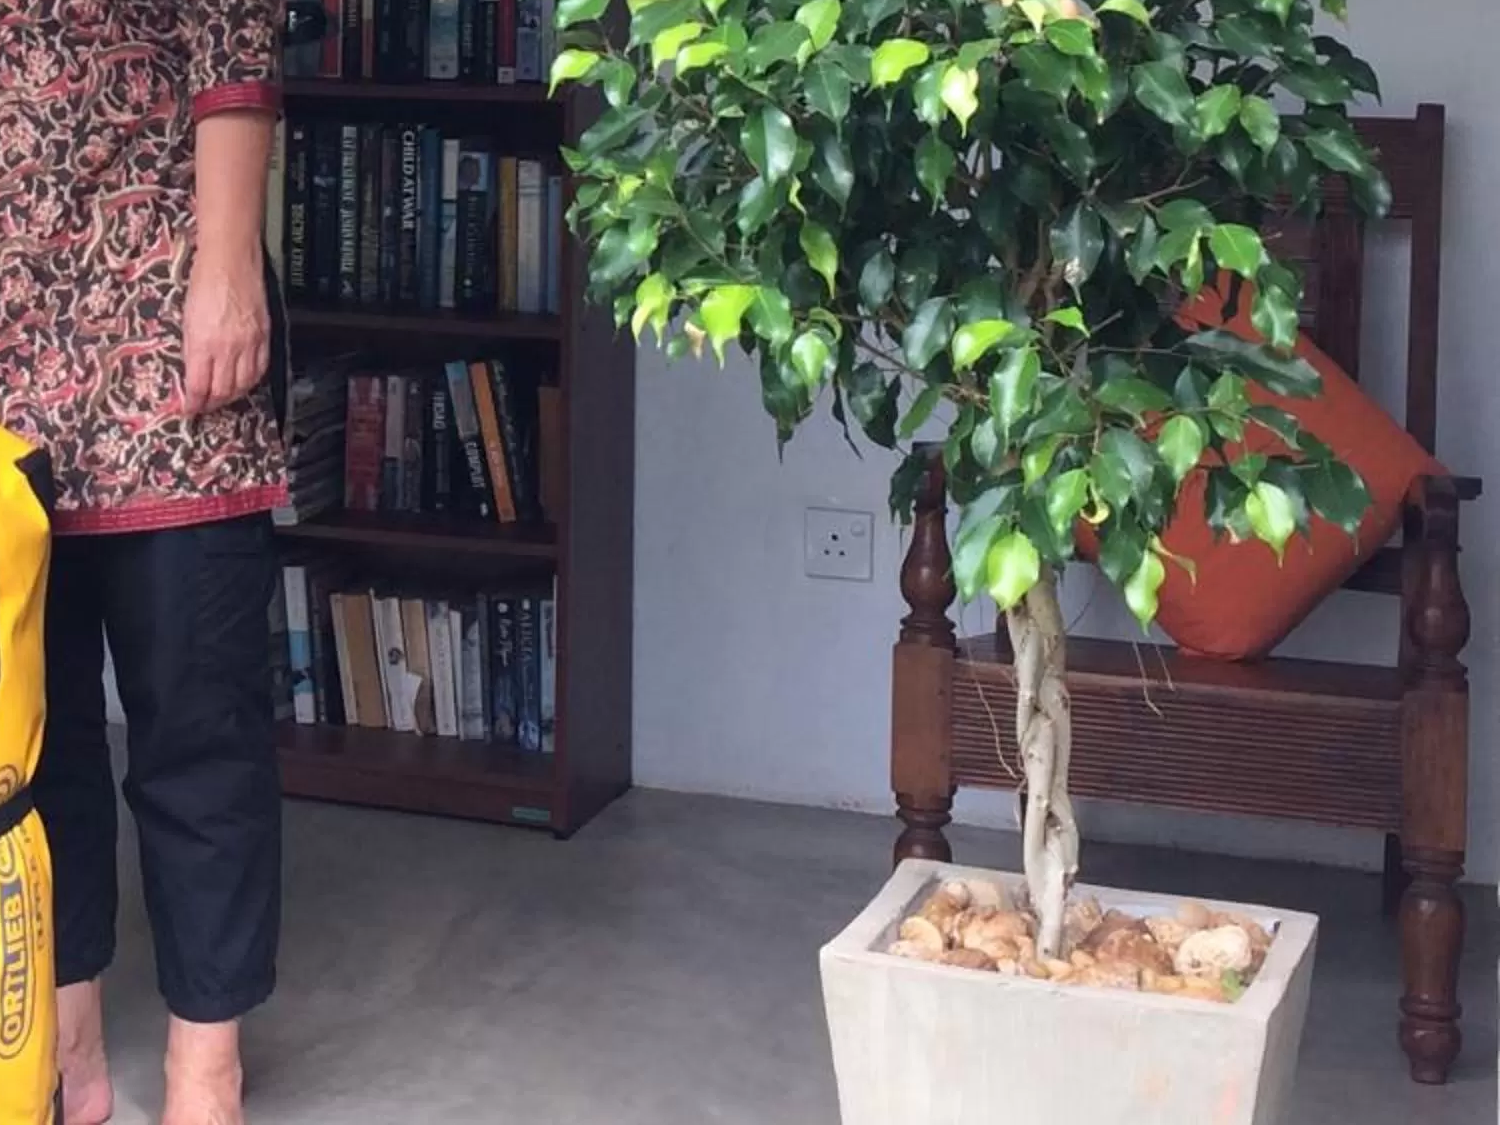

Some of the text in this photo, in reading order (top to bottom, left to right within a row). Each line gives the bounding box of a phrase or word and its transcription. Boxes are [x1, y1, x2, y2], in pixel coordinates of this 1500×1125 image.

[402, 129, 416, 231] CHILD AT WAR
[2, 893, 26, 1041] ORTLIEB
